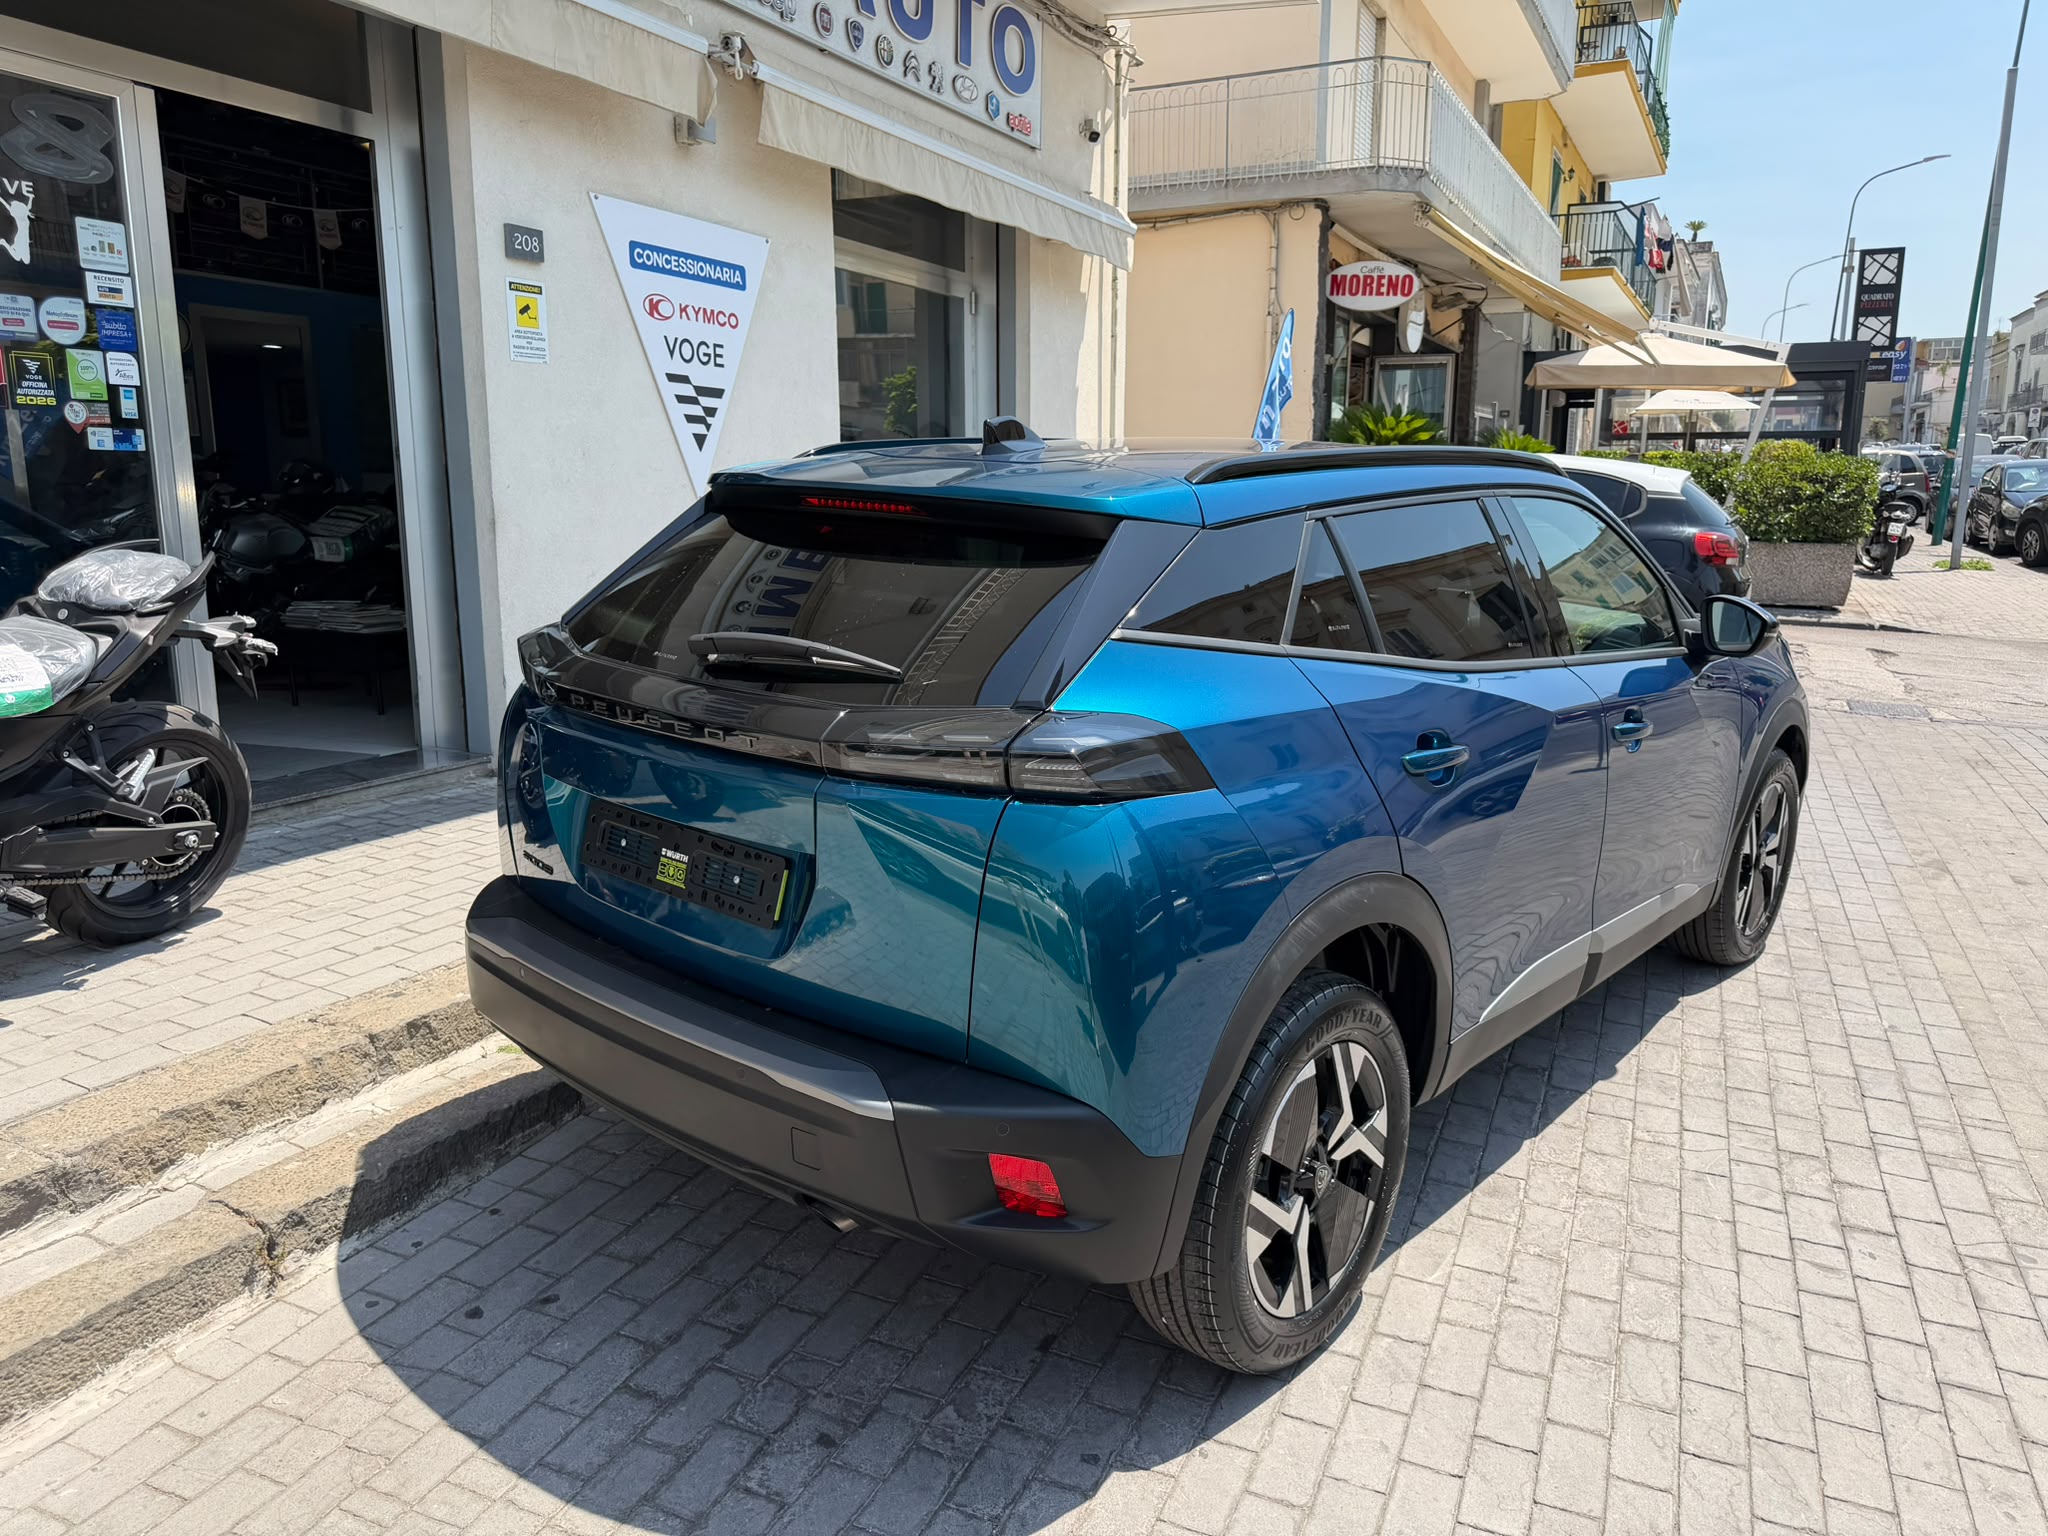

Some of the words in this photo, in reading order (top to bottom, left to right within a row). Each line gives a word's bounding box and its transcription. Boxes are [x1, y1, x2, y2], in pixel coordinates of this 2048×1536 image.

[857, 0, 1036, 96] UTO
[1008, 112, 1032, 137] aprilia
[0, 177, 35, 198] VE
[514, 233, 540, 253] 208
[634, 248, 743, 285] CONCESSIONARIA
[94, 275, 125, 284] RECENSITO
[1329, 274, 1415, 298] MORENO
[1860, 301, 1894, 309] PIZZERIA
[1861, 292, 1895, 302] QUADRATO
[679, 303, 739, 330] KYMCO
[664, 335, 725, 368] VOGE
[1882, 351, 1907, 360] easy
[16, 388, 55, 396] AUTORIZZATA
[21, 381, 48, 389] OFFICINA
[16, 395, 57, 406] 2026
[569, 693, 760, 749] PEUGEOT
[1305, 1007, 1382, 1053] GOODYEAR
